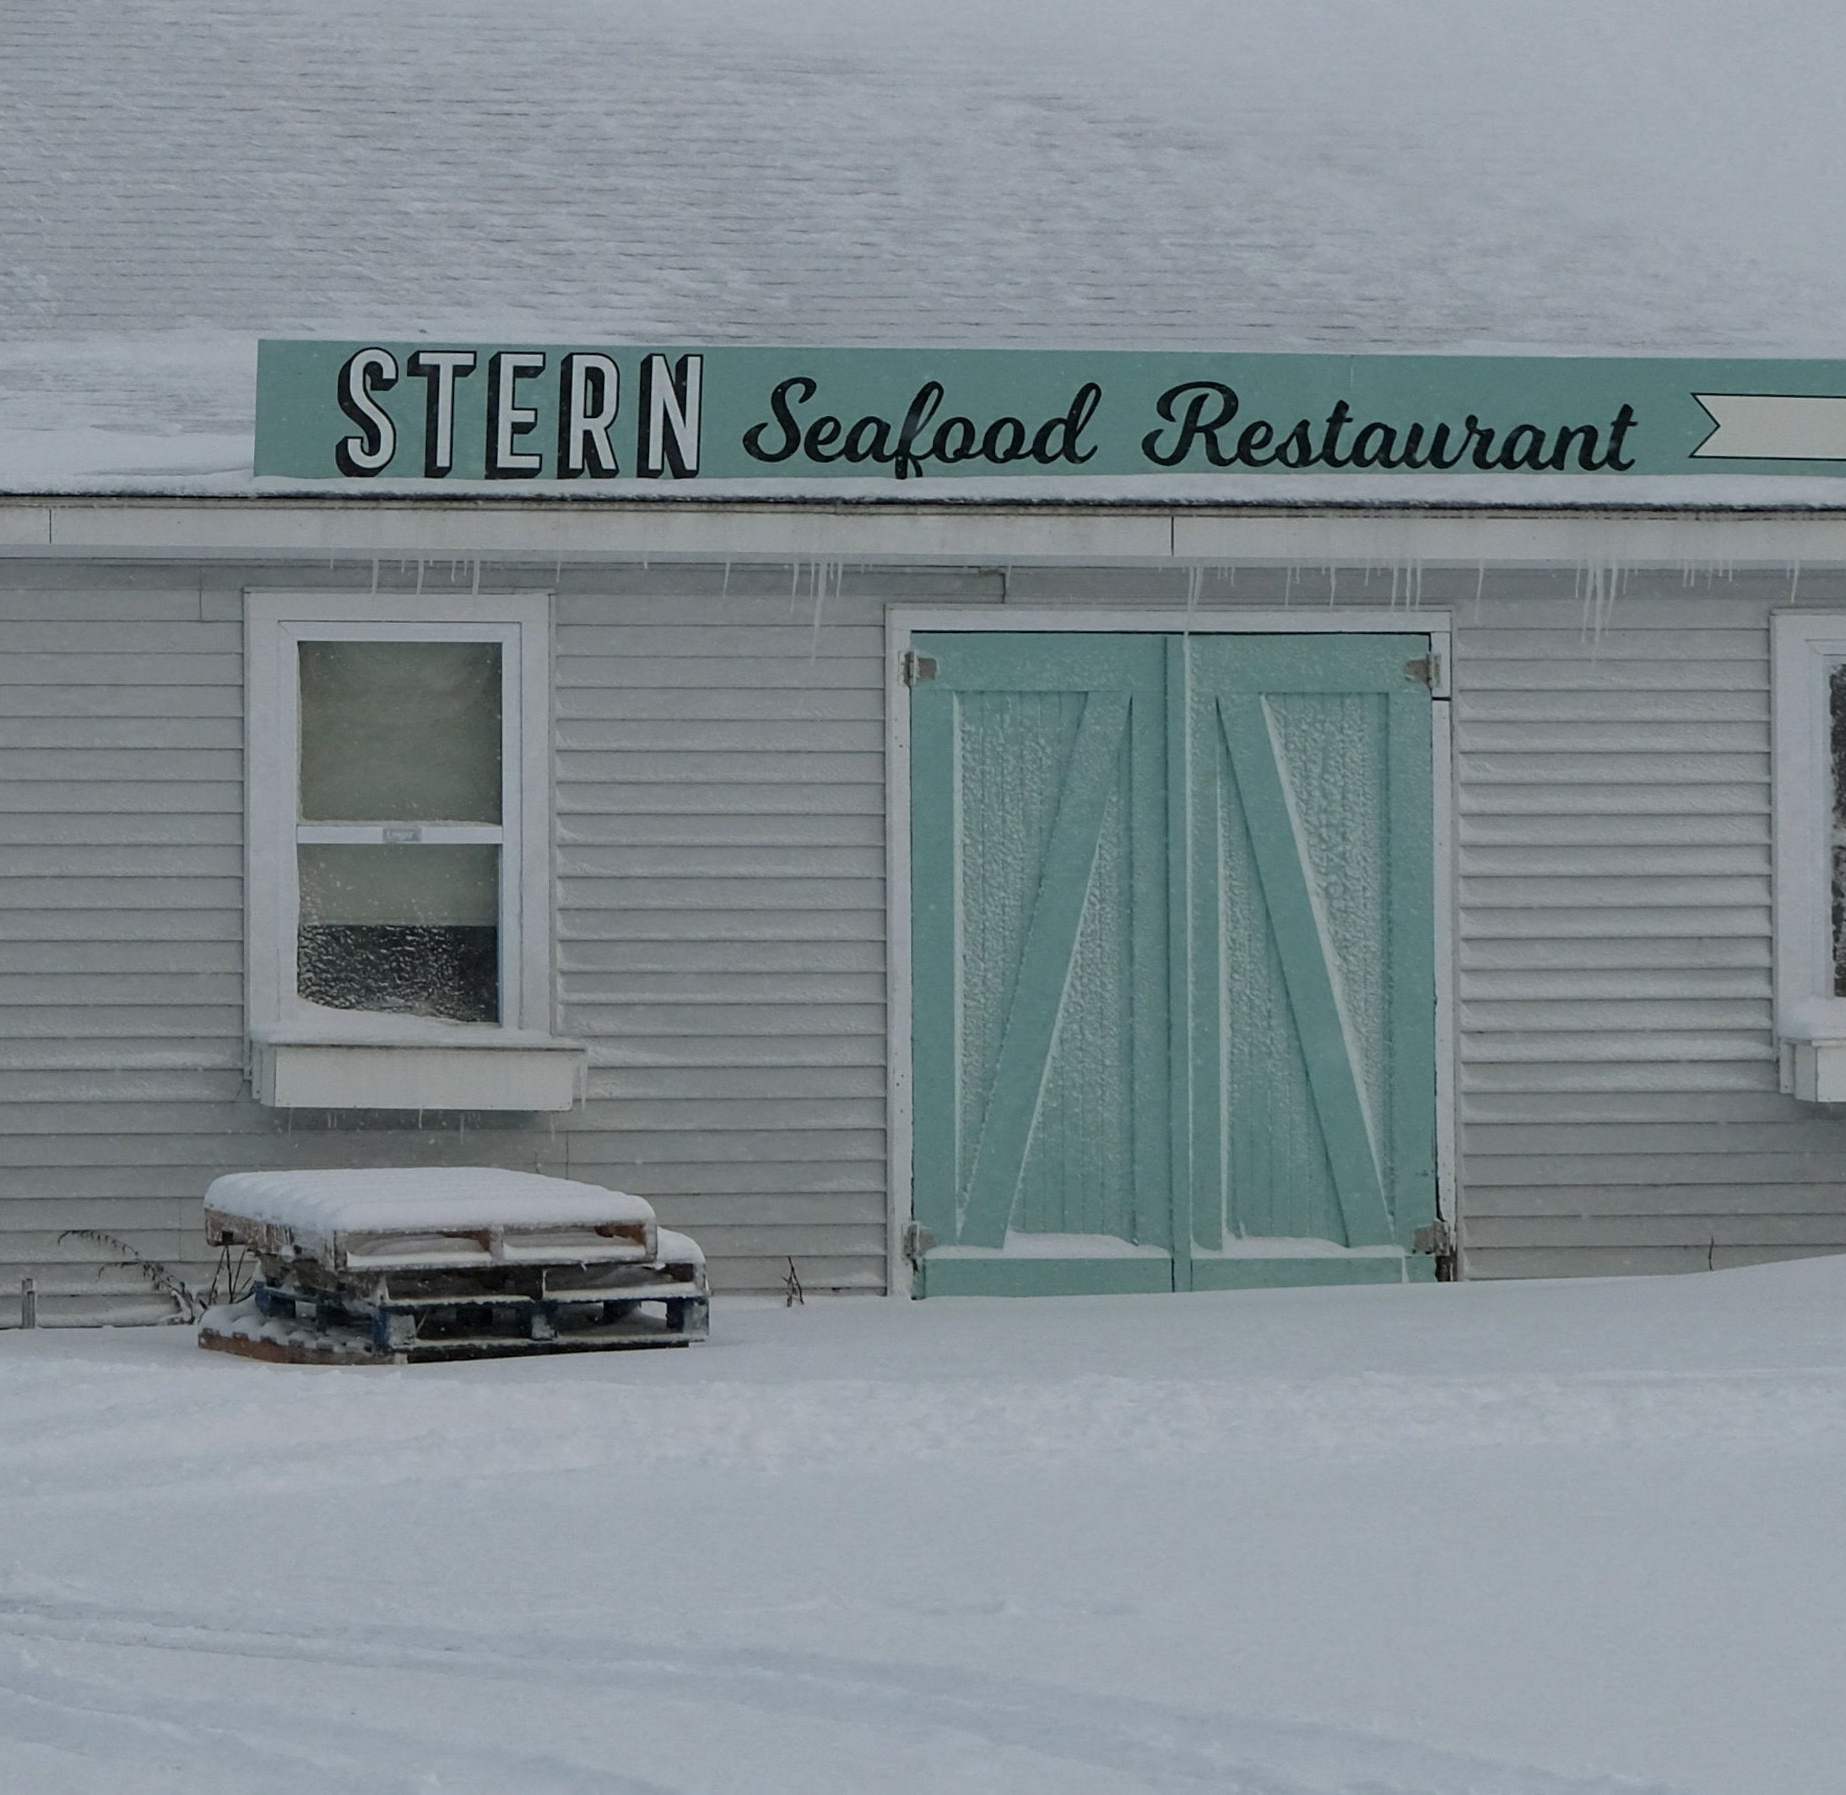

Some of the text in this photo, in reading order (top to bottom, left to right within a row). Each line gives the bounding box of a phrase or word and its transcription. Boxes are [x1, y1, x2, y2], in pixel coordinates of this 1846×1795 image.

[335, 346, 1640, 480] STERN Seafood Restaurant
